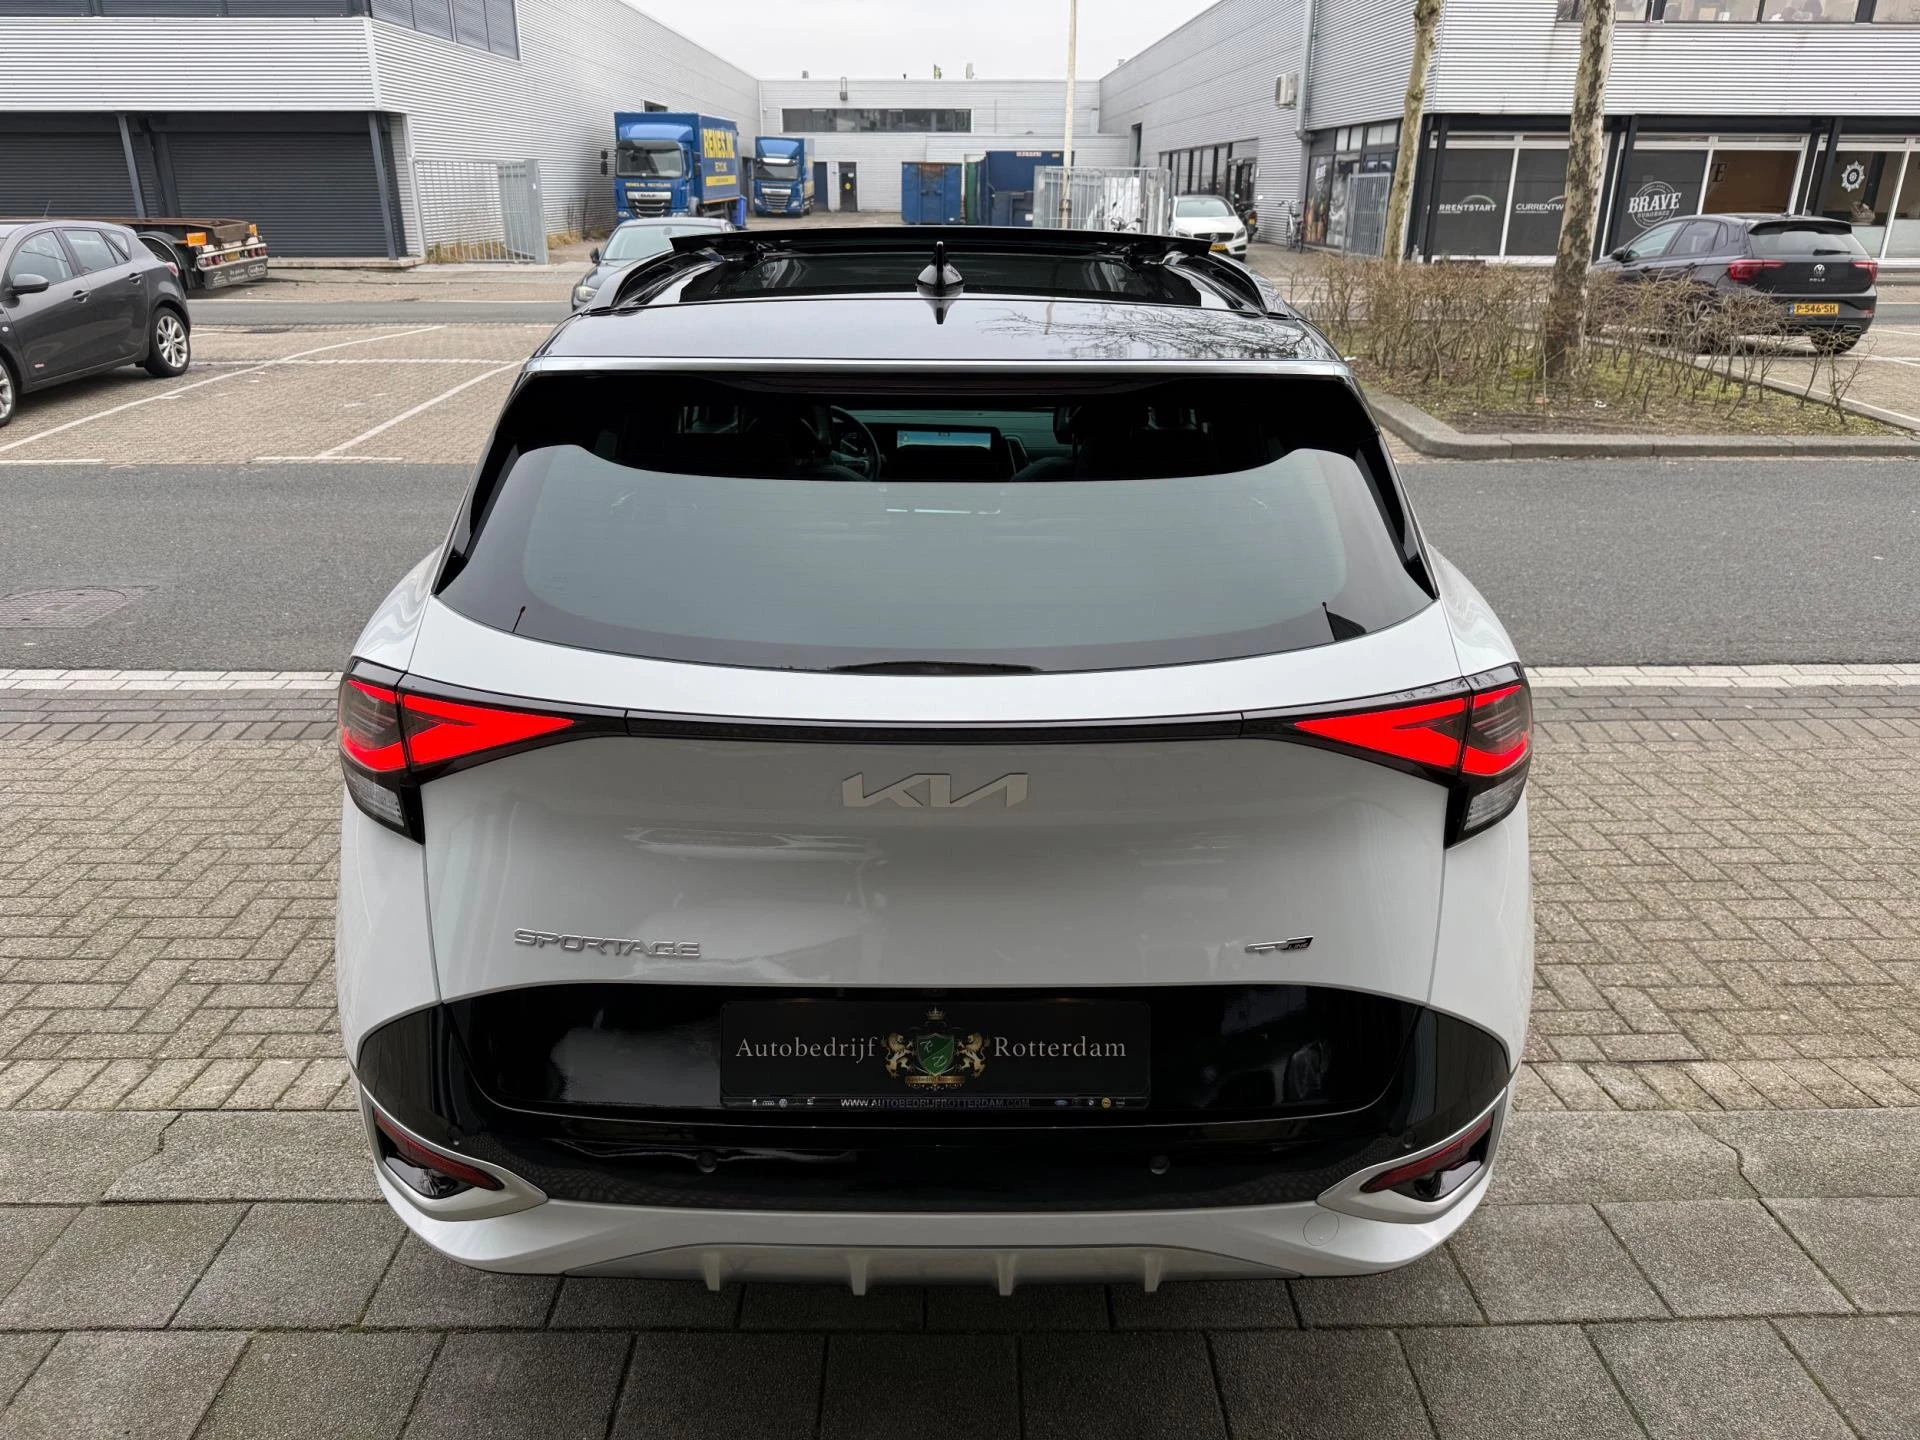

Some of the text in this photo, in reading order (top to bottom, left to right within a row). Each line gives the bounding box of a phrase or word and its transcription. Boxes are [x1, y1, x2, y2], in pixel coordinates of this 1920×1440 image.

[1628, 192, 1682, 213] BRAVE
[842, 772, 1029, 807] KIA
[514, 928, 701, 958] SPORTAGE
[736, 1035, 1127, 1064] Autobedrijf Rotterdam
